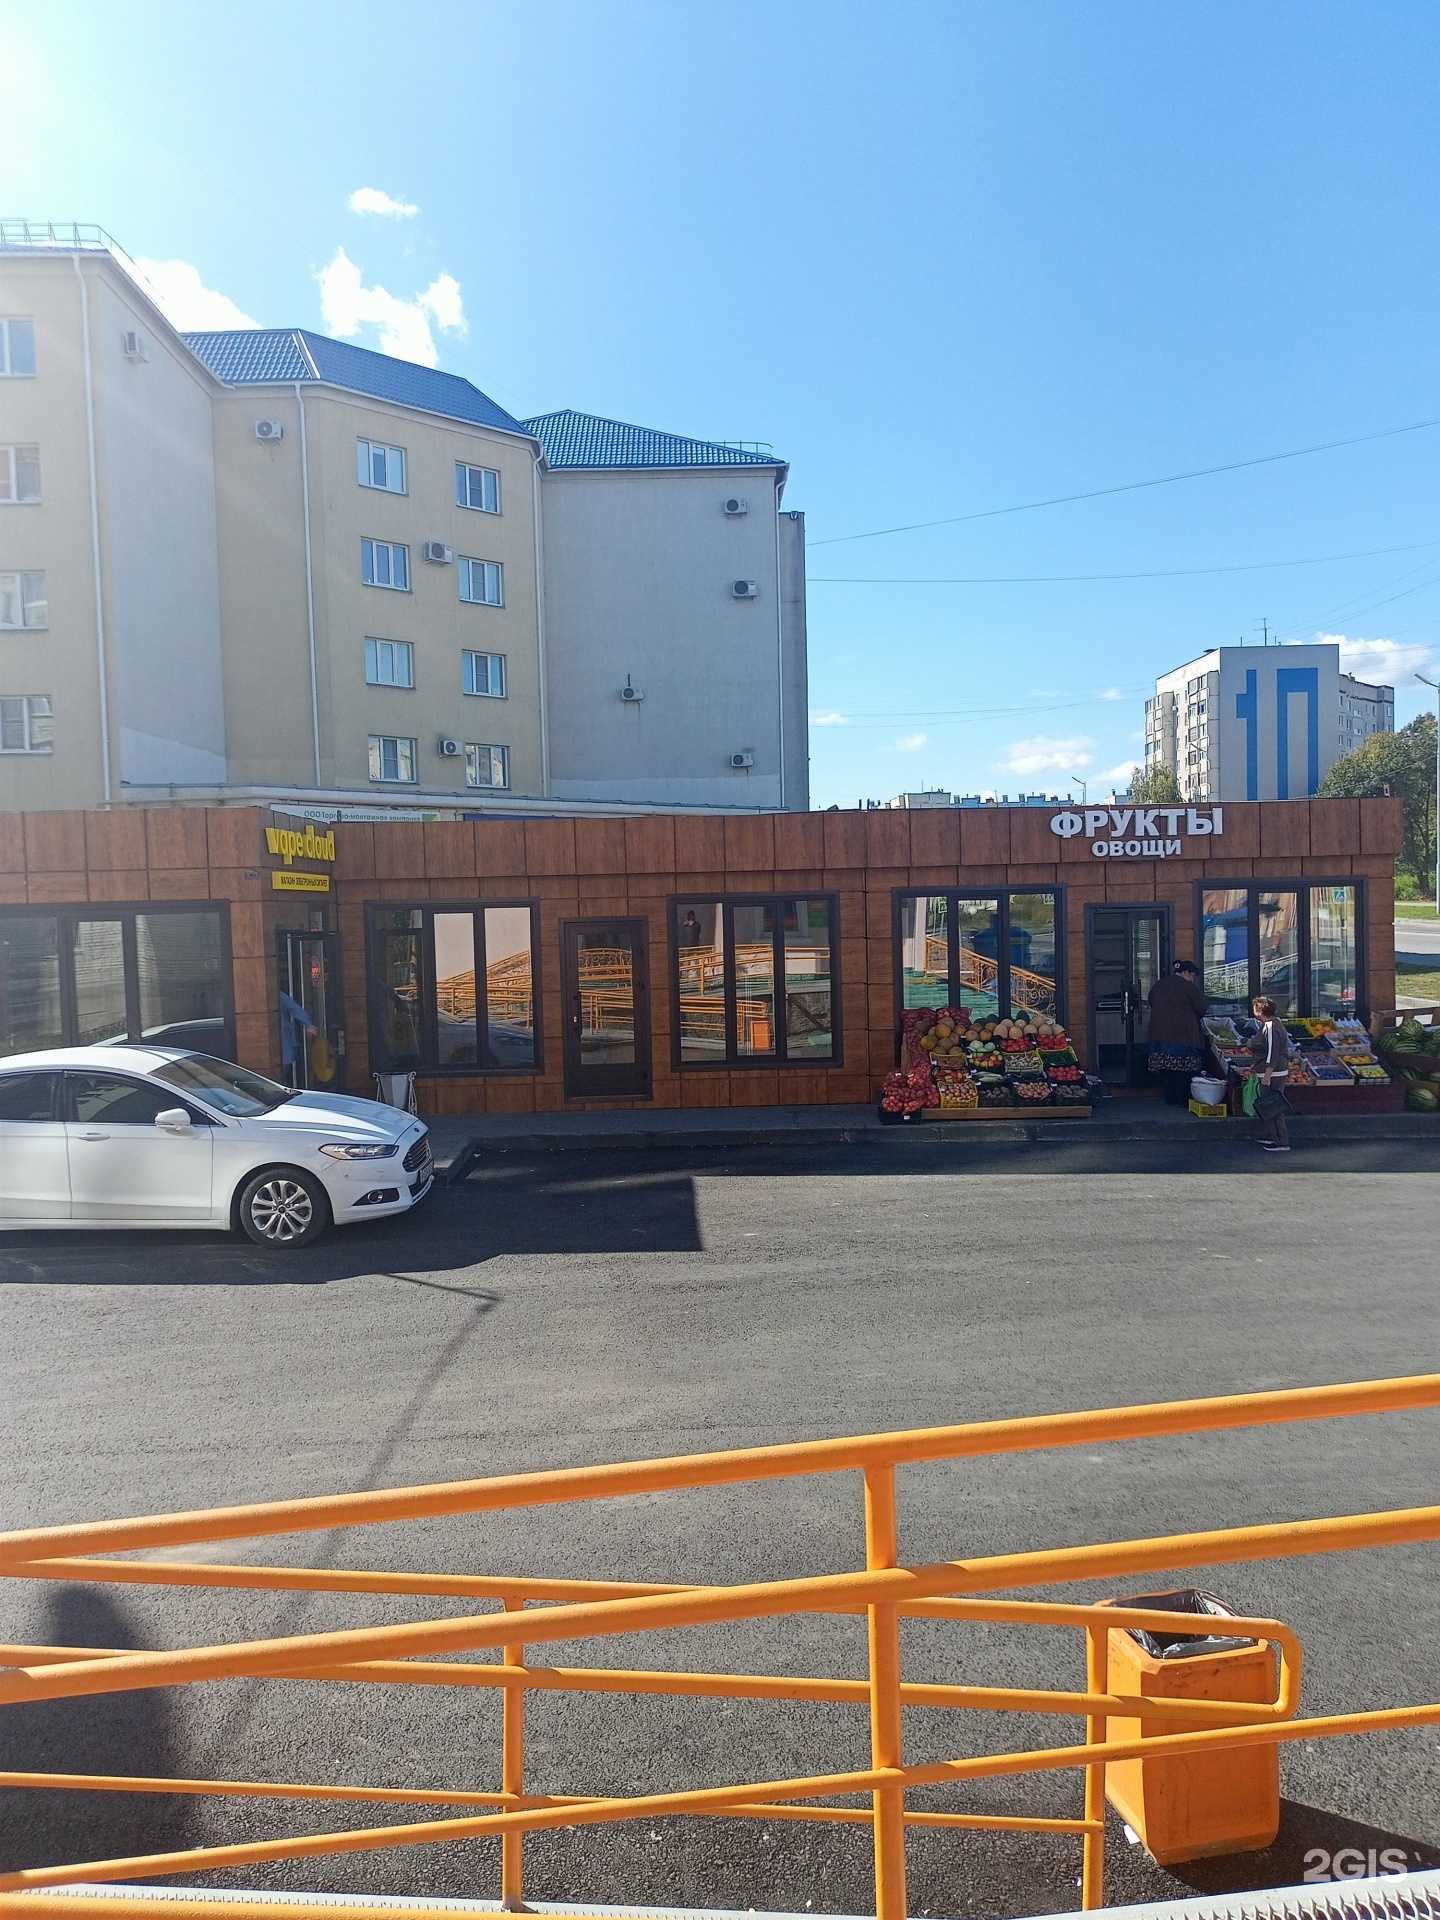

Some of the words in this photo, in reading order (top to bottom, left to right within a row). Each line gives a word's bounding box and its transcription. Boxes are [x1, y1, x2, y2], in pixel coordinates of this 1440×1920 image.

[304, 810, 321, 818] ООО
[1050, 807, 1223, 838] ФРУКТЫ
[265, 828, 304, 864] vape
[304, 825, 336, 861] cloud
[1091, 840, 1182, 858] ОВОЩИ
